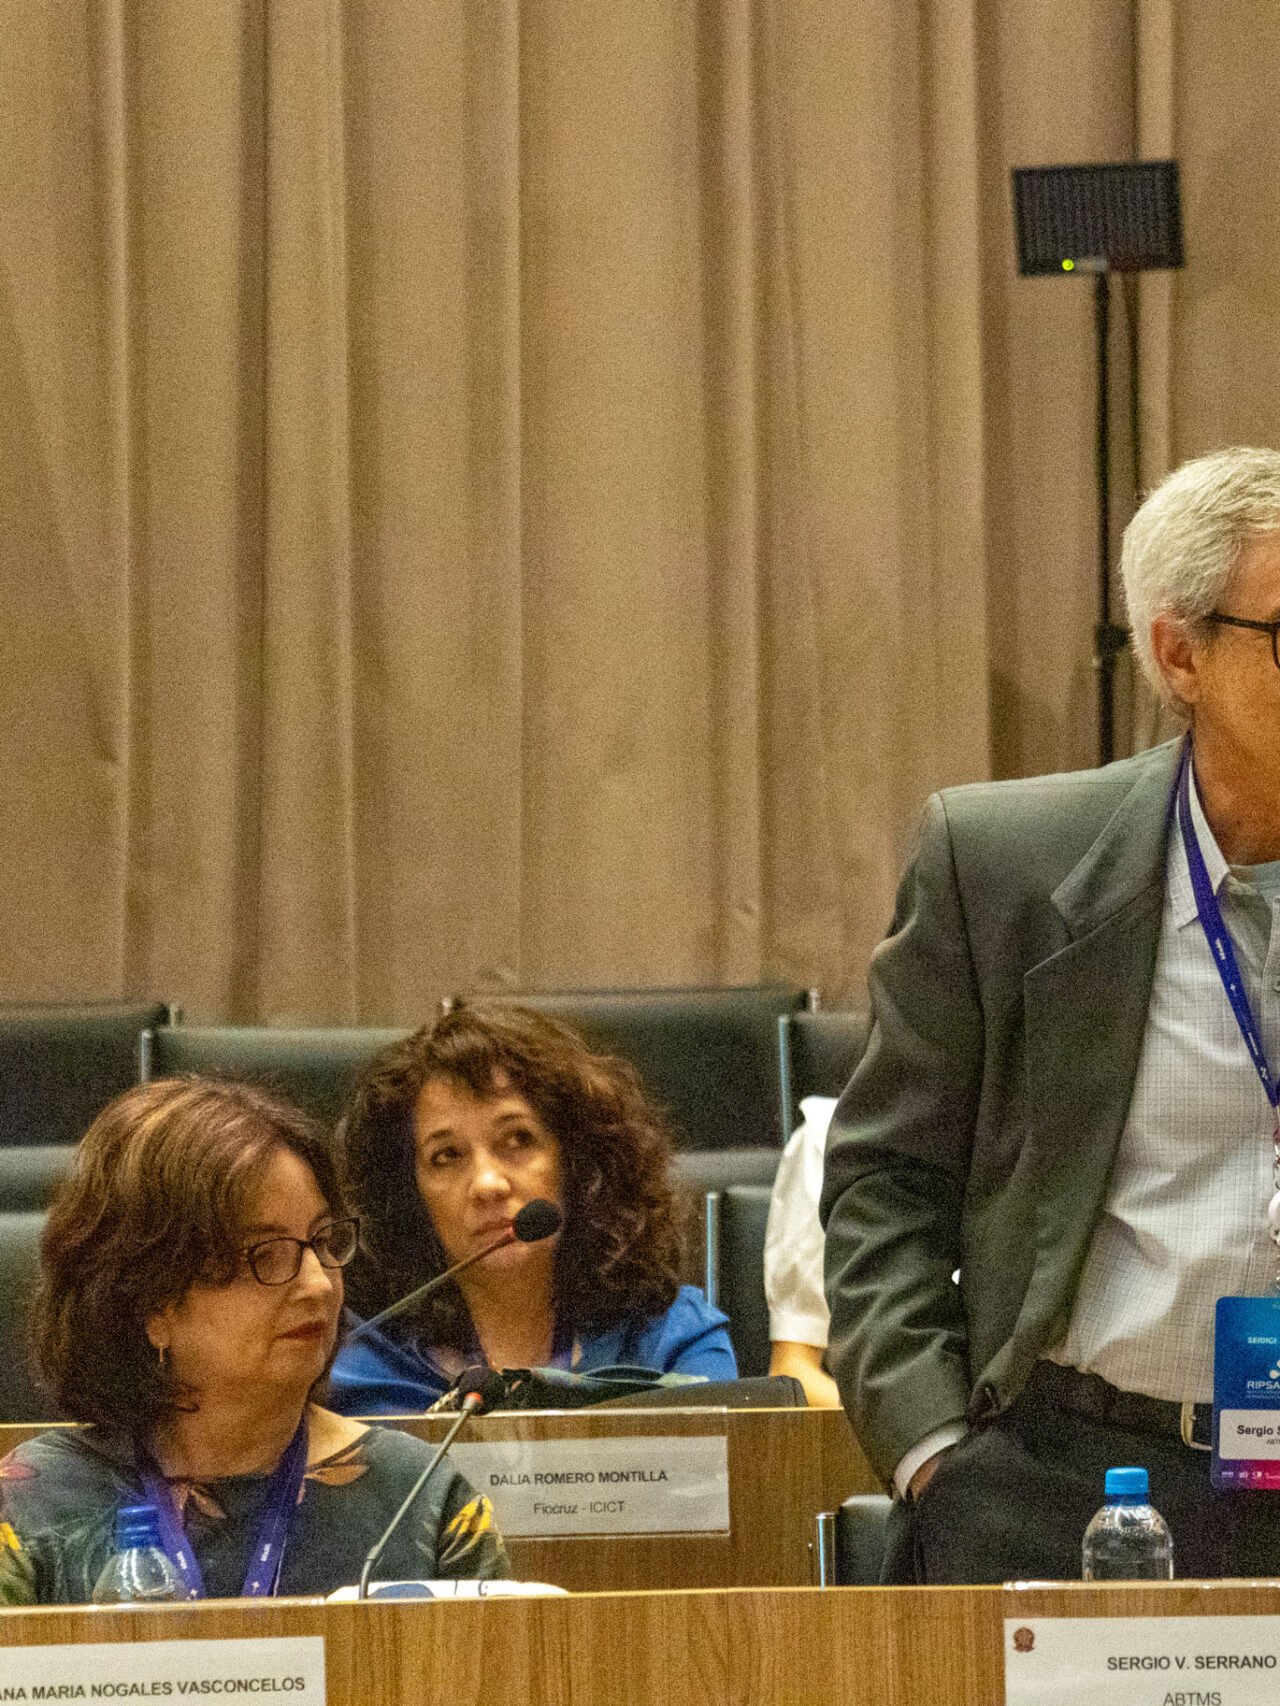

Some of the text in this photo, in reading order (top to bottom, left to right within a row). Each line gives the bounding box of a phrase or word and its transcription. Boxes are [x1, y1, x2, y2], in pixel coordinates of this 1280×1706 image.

[1246, 1380, 1280, 1390] RIPSA
[1236, 1425, 1274, 1438] Sergio
[489, 1469, 669, 1487] DALIA ROMERO MONTILLA
[533, 1501, 579, 1515] Fiocruz
[589, 1499, 626, 1514] ICICT
[1106, 1654, 1278, 1671] SERGIO V. SERRANO
[31, 1684, 87, 1701] MARIA
[90, 1680, 173, 1698] NOGALES
[176, 1676, 306, 1695] VASCONCELOS
[1163, 1691, 1223, 1706] ABTMS
